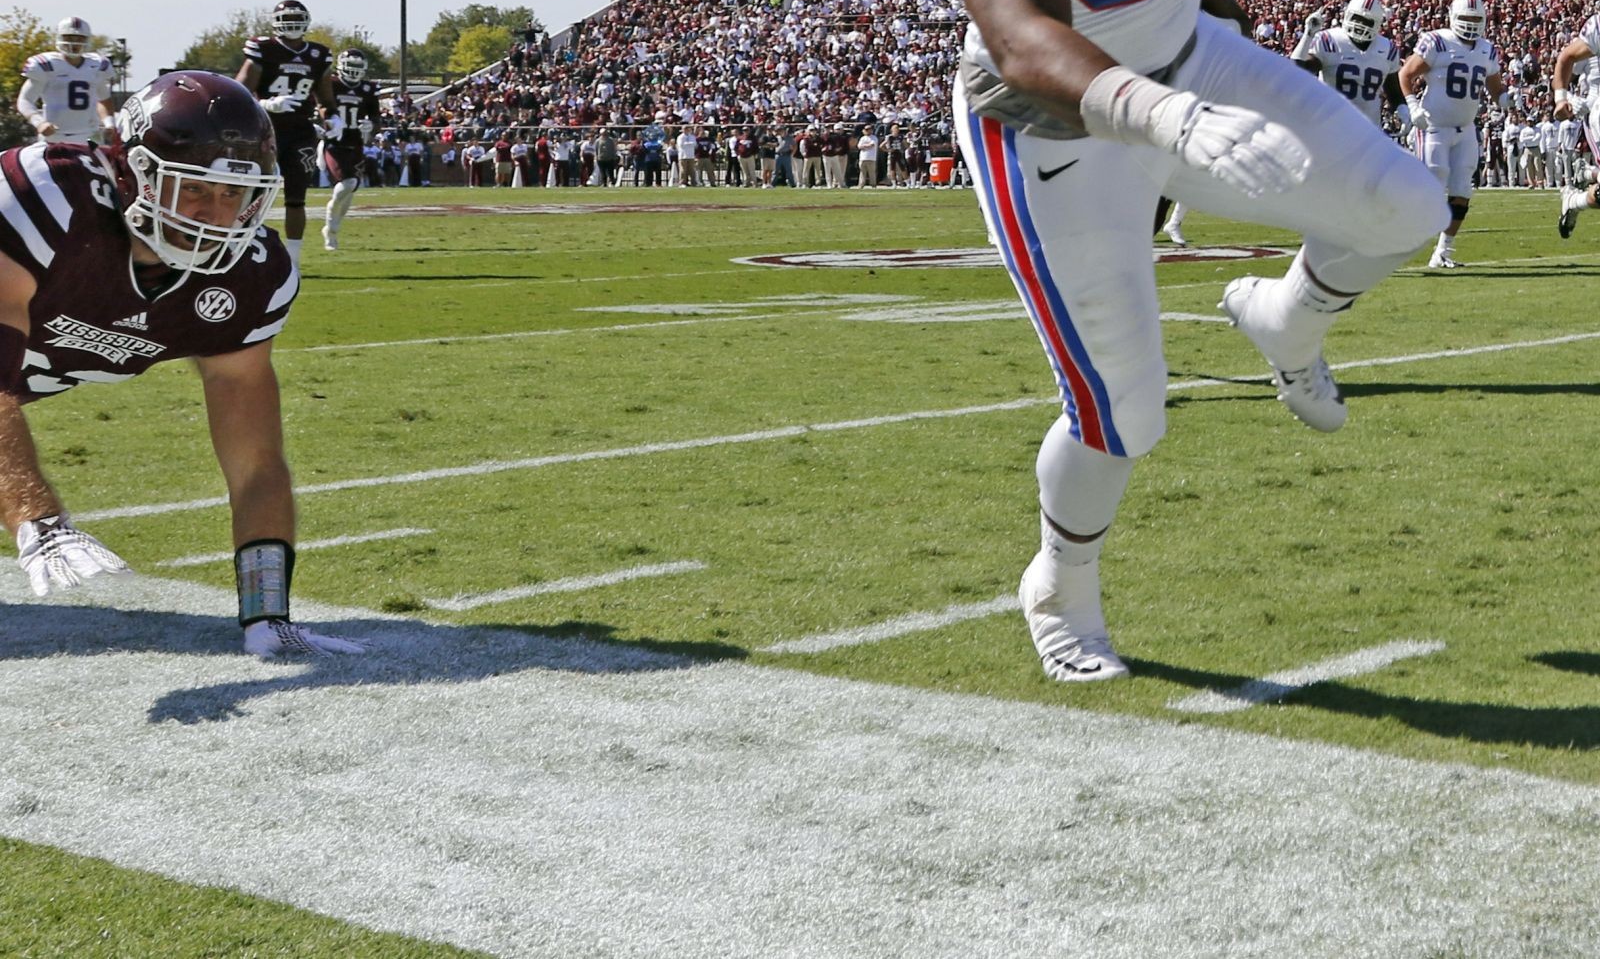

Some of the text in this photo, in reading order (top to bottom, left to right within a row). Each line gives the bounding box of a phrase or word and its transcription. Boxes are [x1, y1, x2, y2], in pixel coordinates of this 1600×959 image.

[68, 81, 90, 111] 6
[268, 75, 315, 101] 48
[197, 289, 234, 320] SEC
[47, 316, 164, 356] MISSISSIPPI
[112, 320, 149, 331] adidas
[63, 338, 119, 361] STATE
